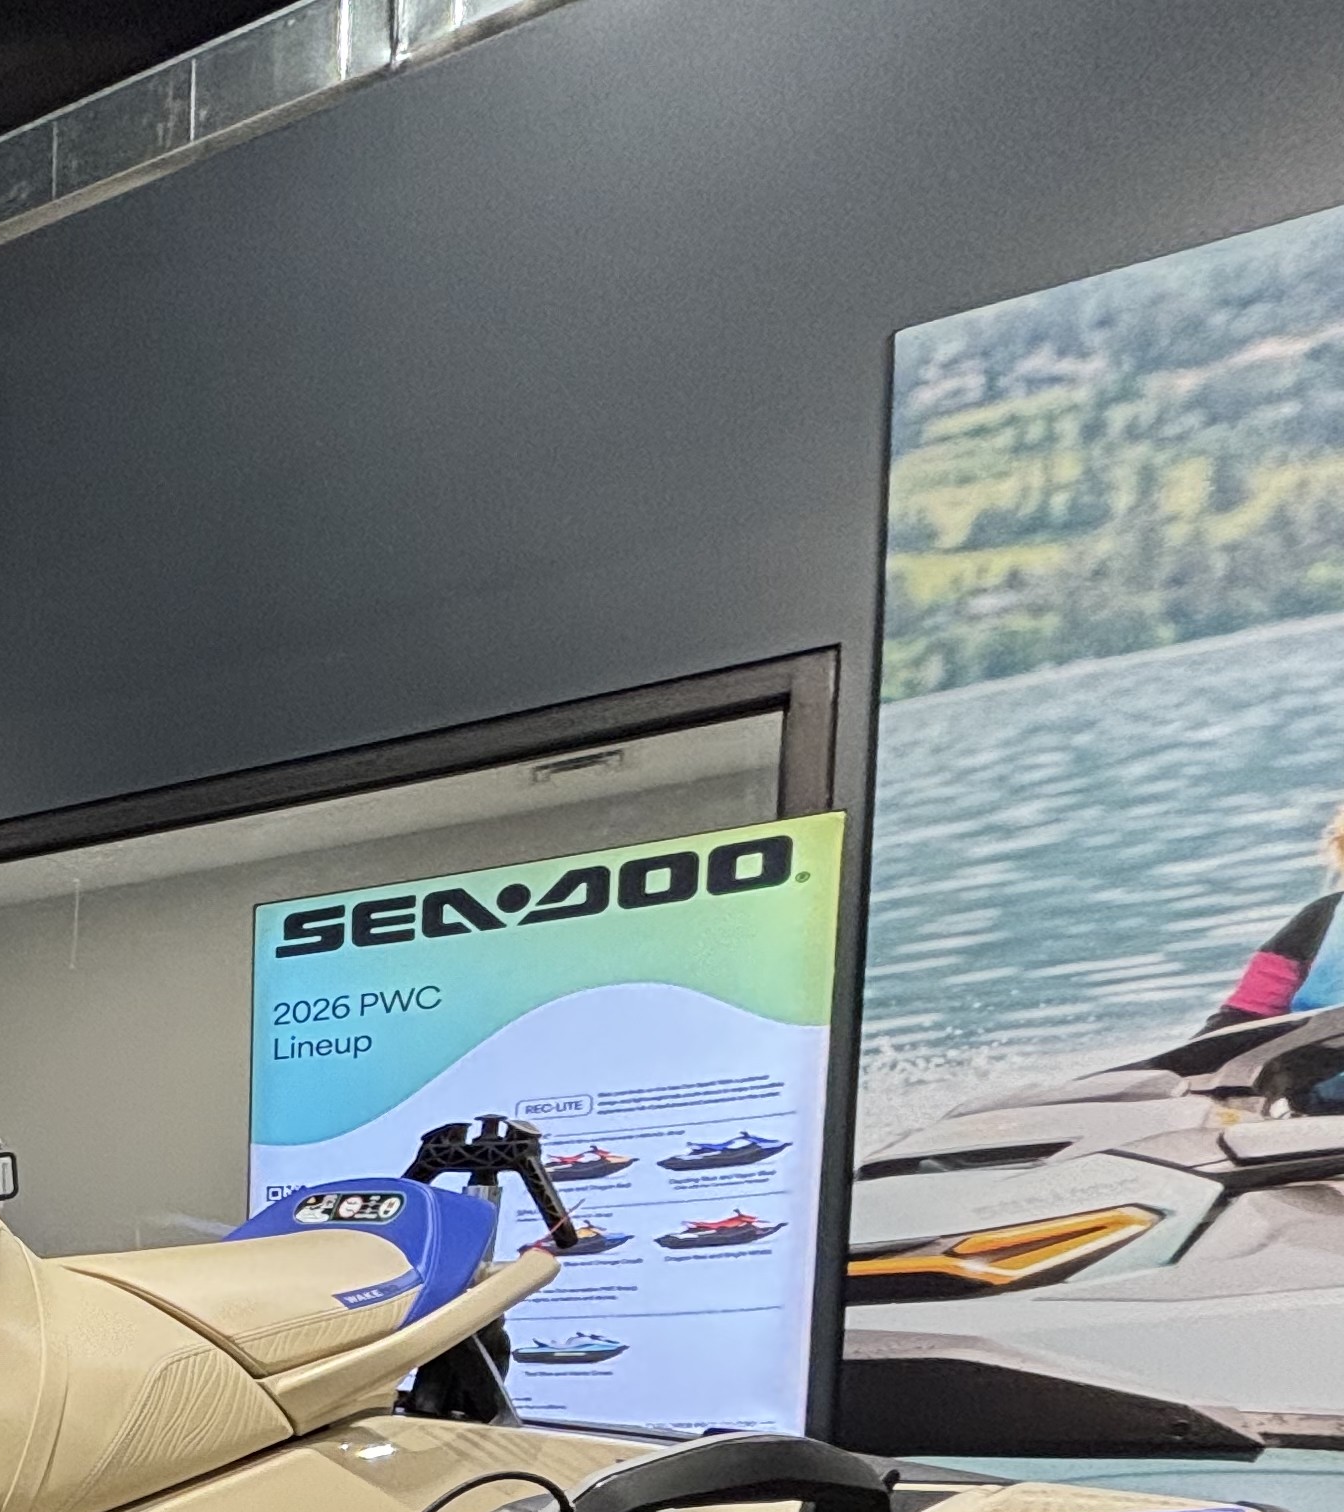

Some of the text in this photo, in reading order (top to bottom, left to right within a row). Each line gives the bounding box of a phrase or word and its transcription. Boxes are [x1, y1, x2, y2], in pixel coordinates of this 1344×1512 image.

[273, 985, 443, 1026] 2026 PWC
[273, 1034, 373, 1060] Lineup
